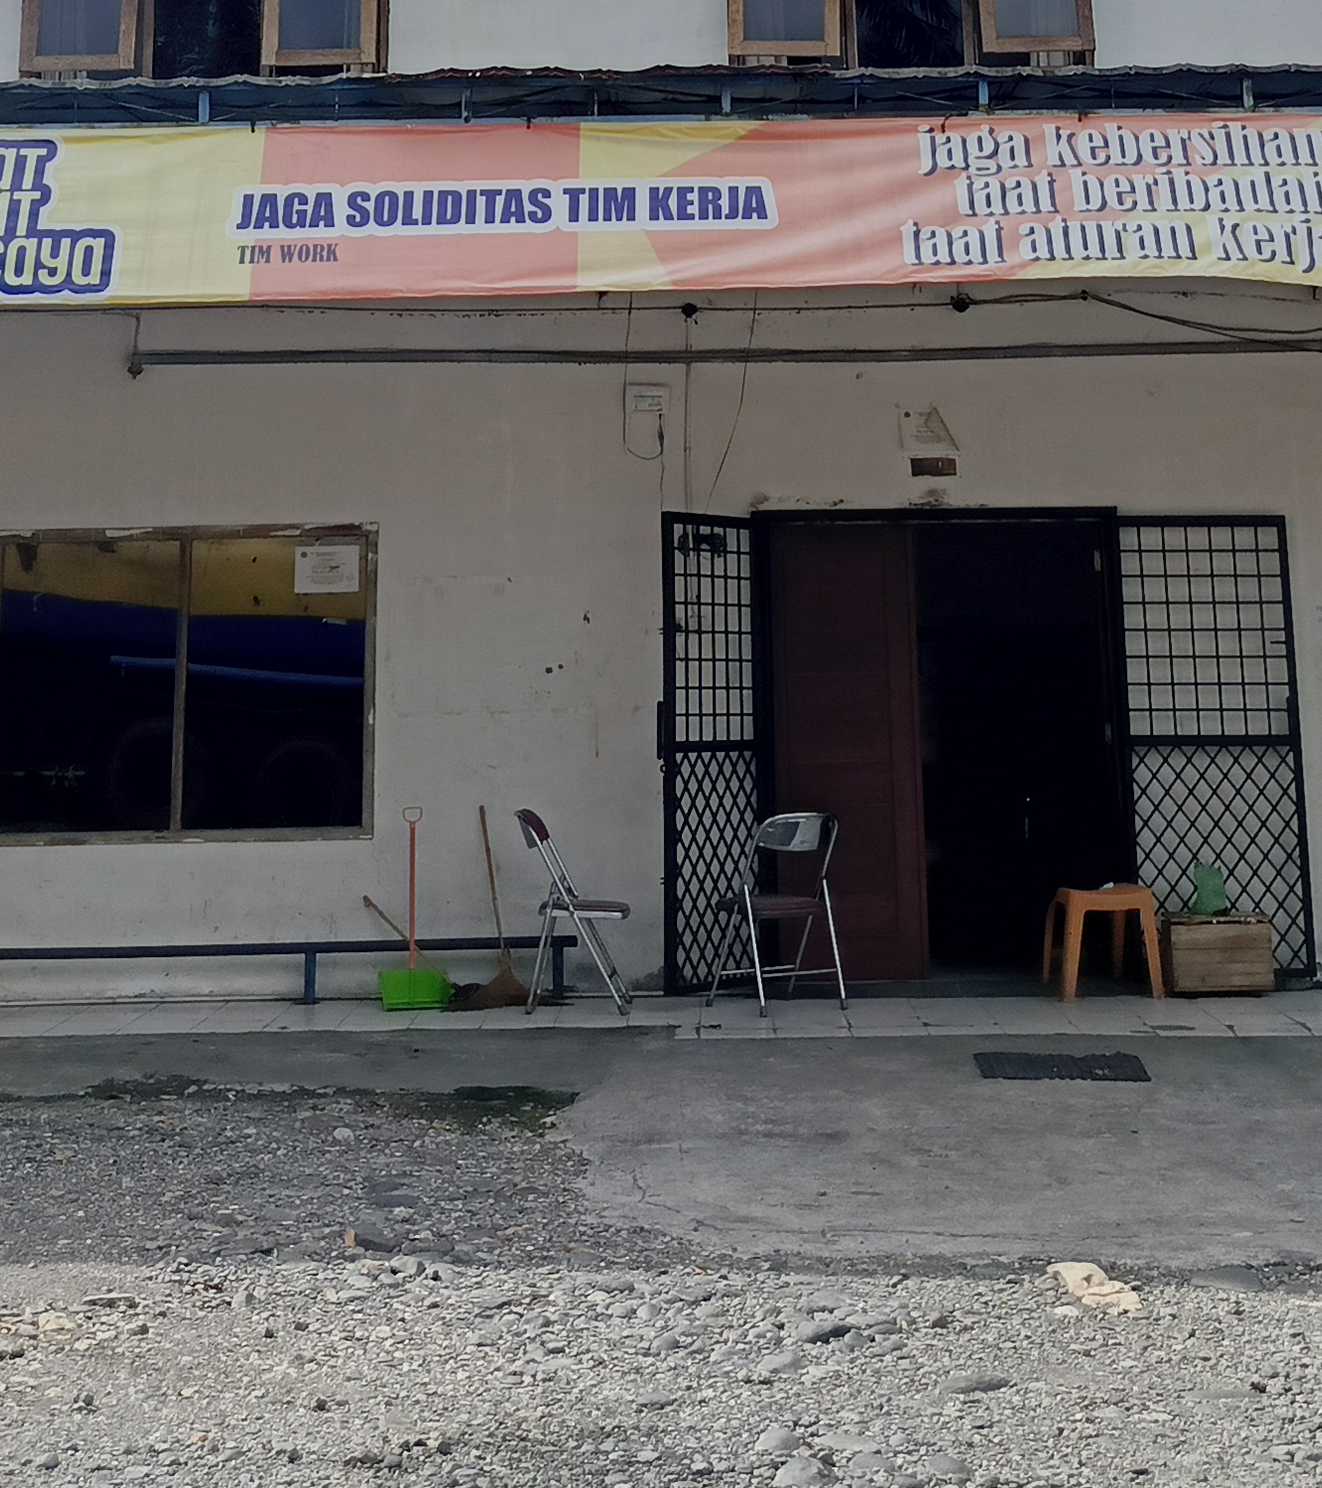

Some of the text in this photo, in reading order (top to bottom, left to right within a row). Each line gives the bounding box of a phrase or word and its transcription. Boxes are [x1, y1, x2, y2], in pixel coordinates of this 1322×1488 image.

[917, 124, 1034, 177] jaga
[236, 185, 768, 230] JAGA SOLIDITAS TIM KERJA
[954, 170, 1060, 217] taat
[237, 243, 339, 264] TIM WORK
[900, 218, 1006, 265] taat
[1017, 215, 1198, 261] aturan
